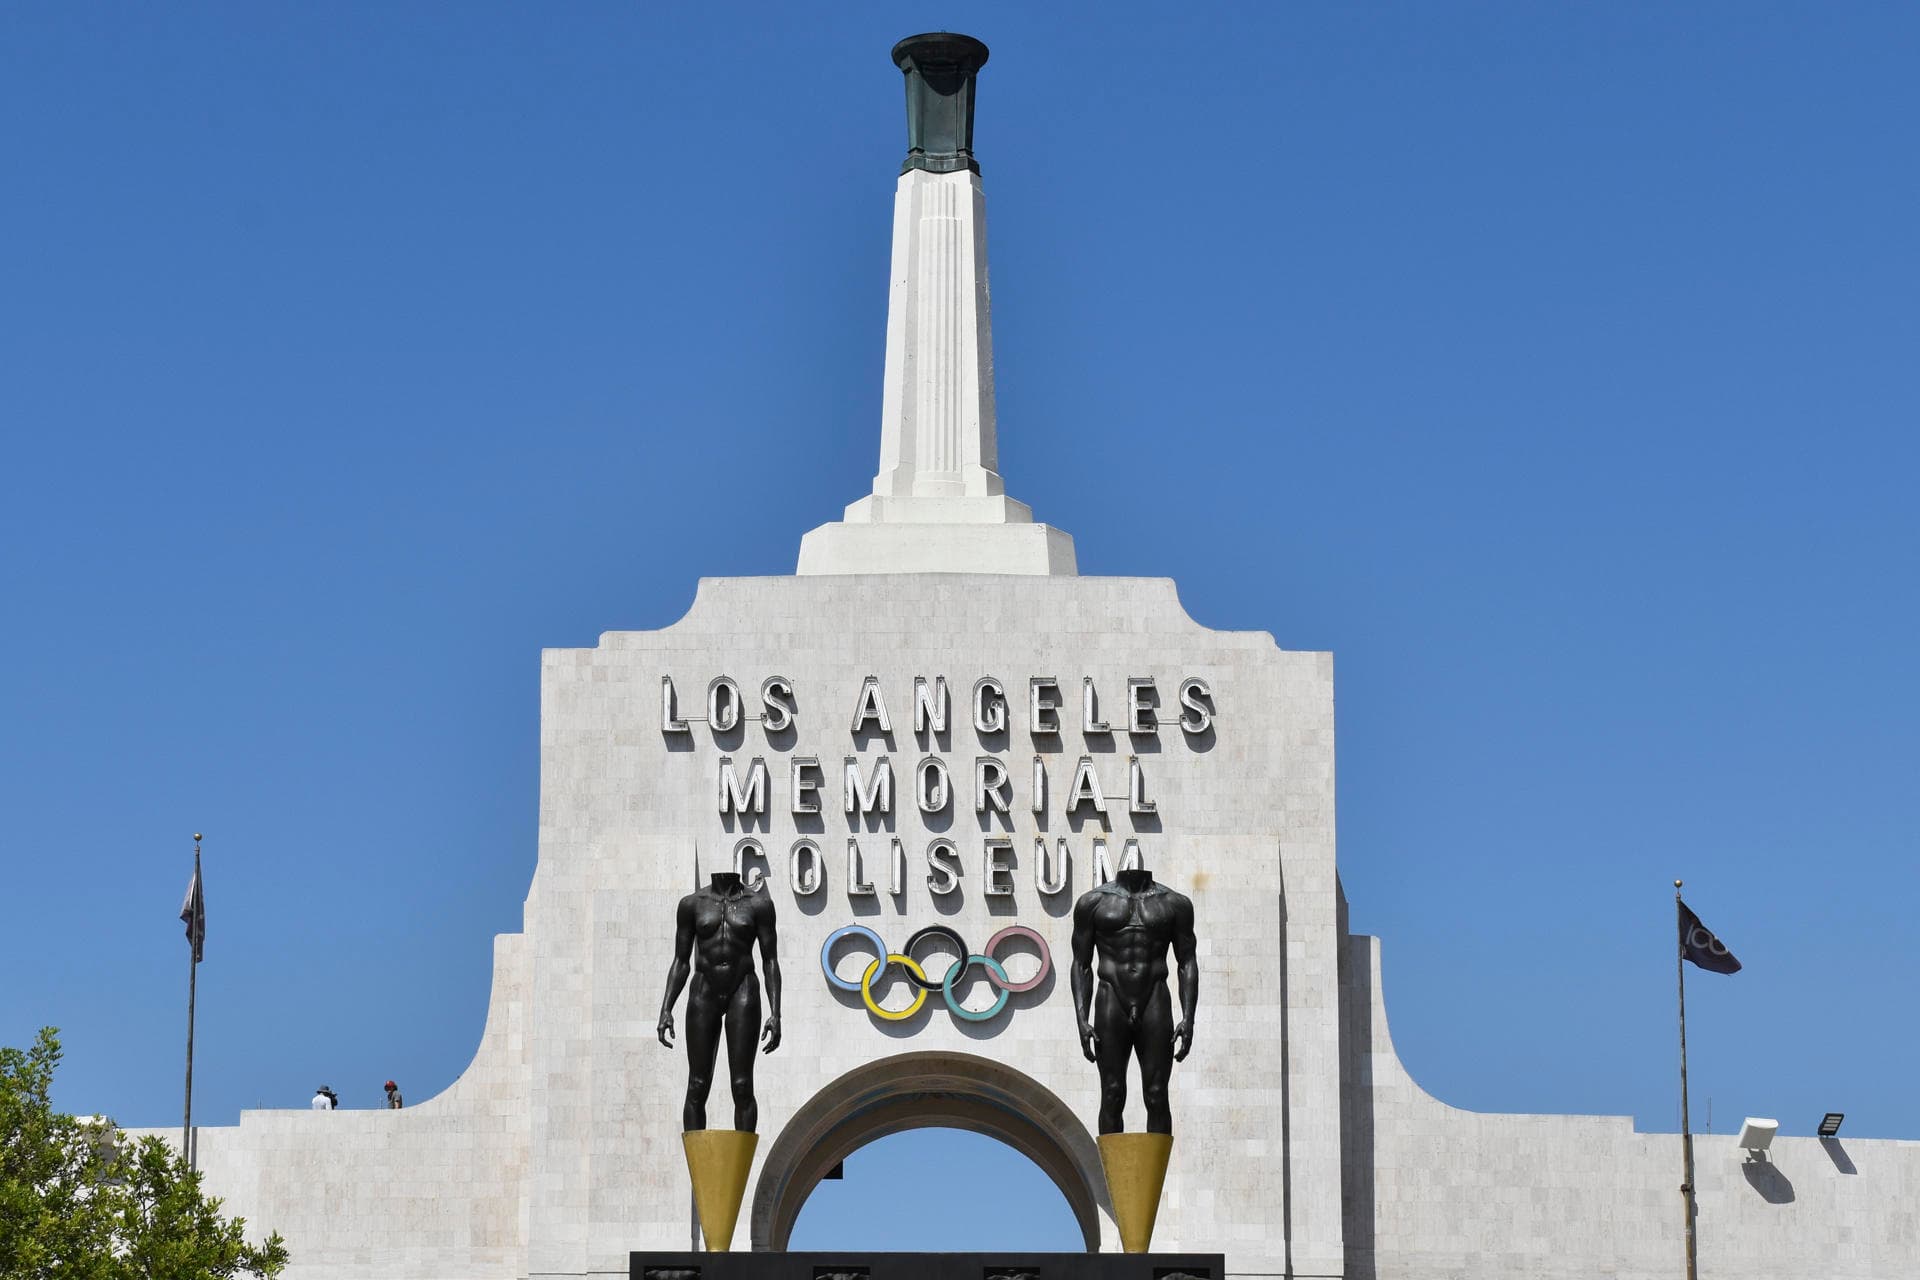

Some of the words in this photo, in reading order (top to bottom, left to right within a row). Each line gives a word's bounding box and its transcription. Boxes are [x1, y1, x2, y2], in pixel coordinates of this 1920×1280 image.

[661, 676, 793, 732] LOS
[851, 676, 1211, 734] ANGELES
[719, 755, 1157, 813] MEMORIAL
[734, 837, 1139, 895] COLISEUM
